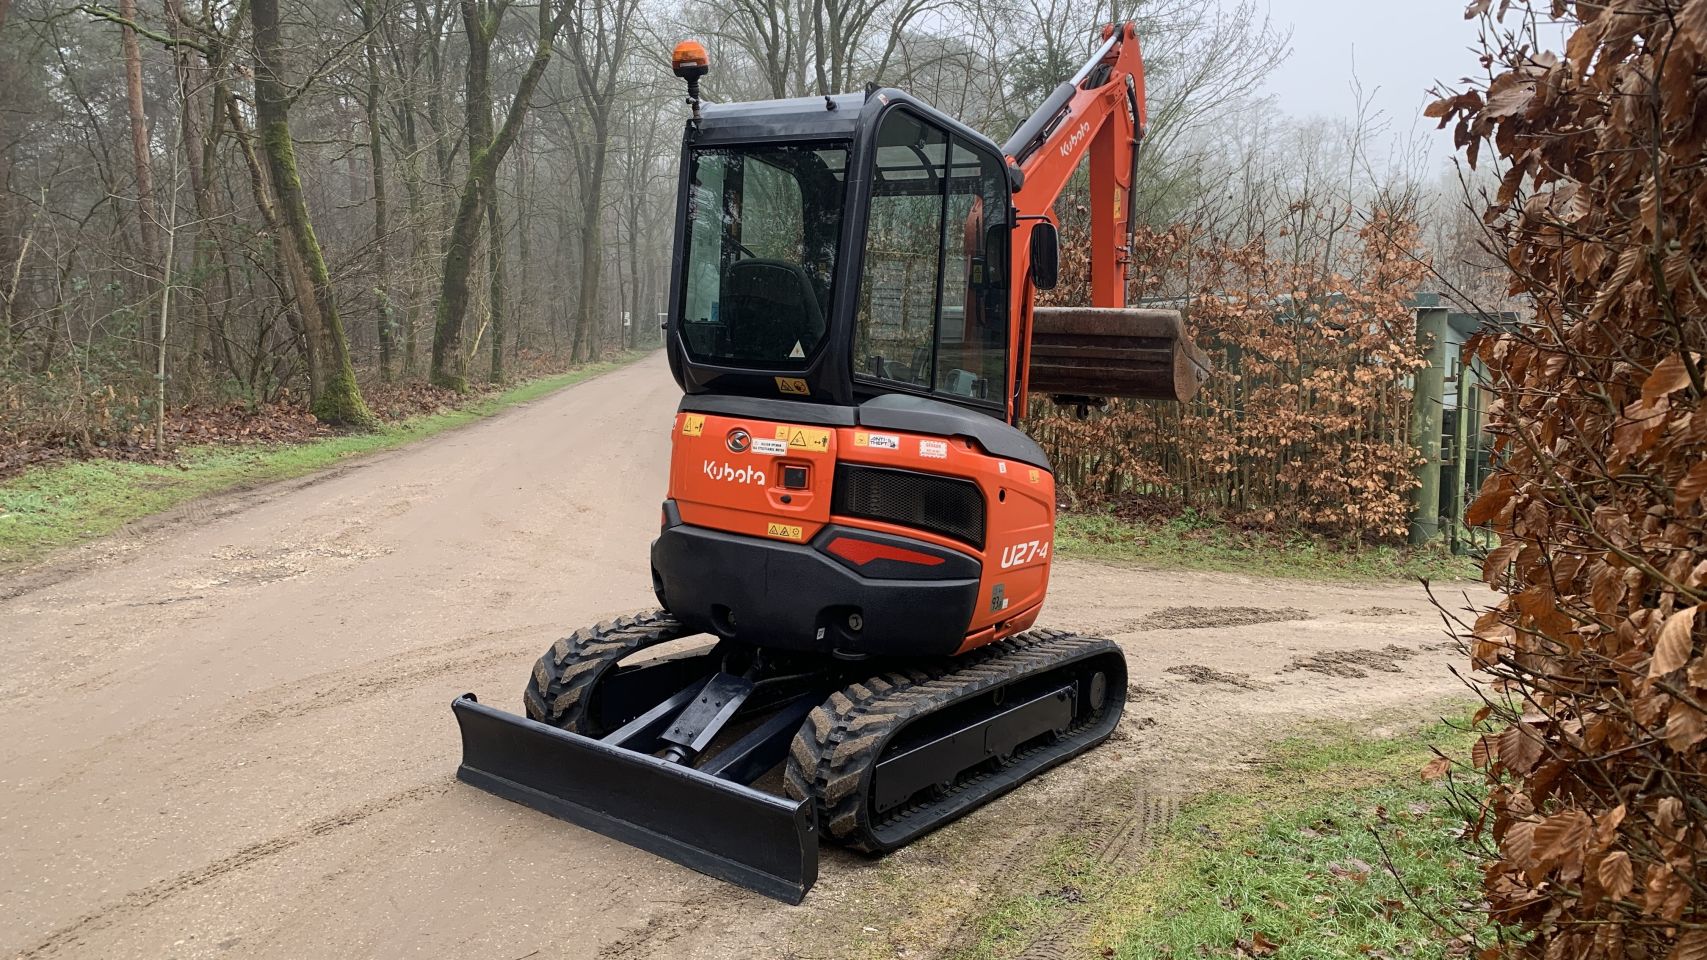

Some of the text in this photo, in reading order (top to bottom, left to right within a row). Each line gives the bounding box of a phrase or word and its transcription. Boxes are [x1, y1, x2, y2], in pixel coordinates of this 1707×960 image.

[1060, 121, 1090, 157] Kubota
[703, 460, 766, 485] Kubota
[1001, 540, 1049, 568] U27-4
